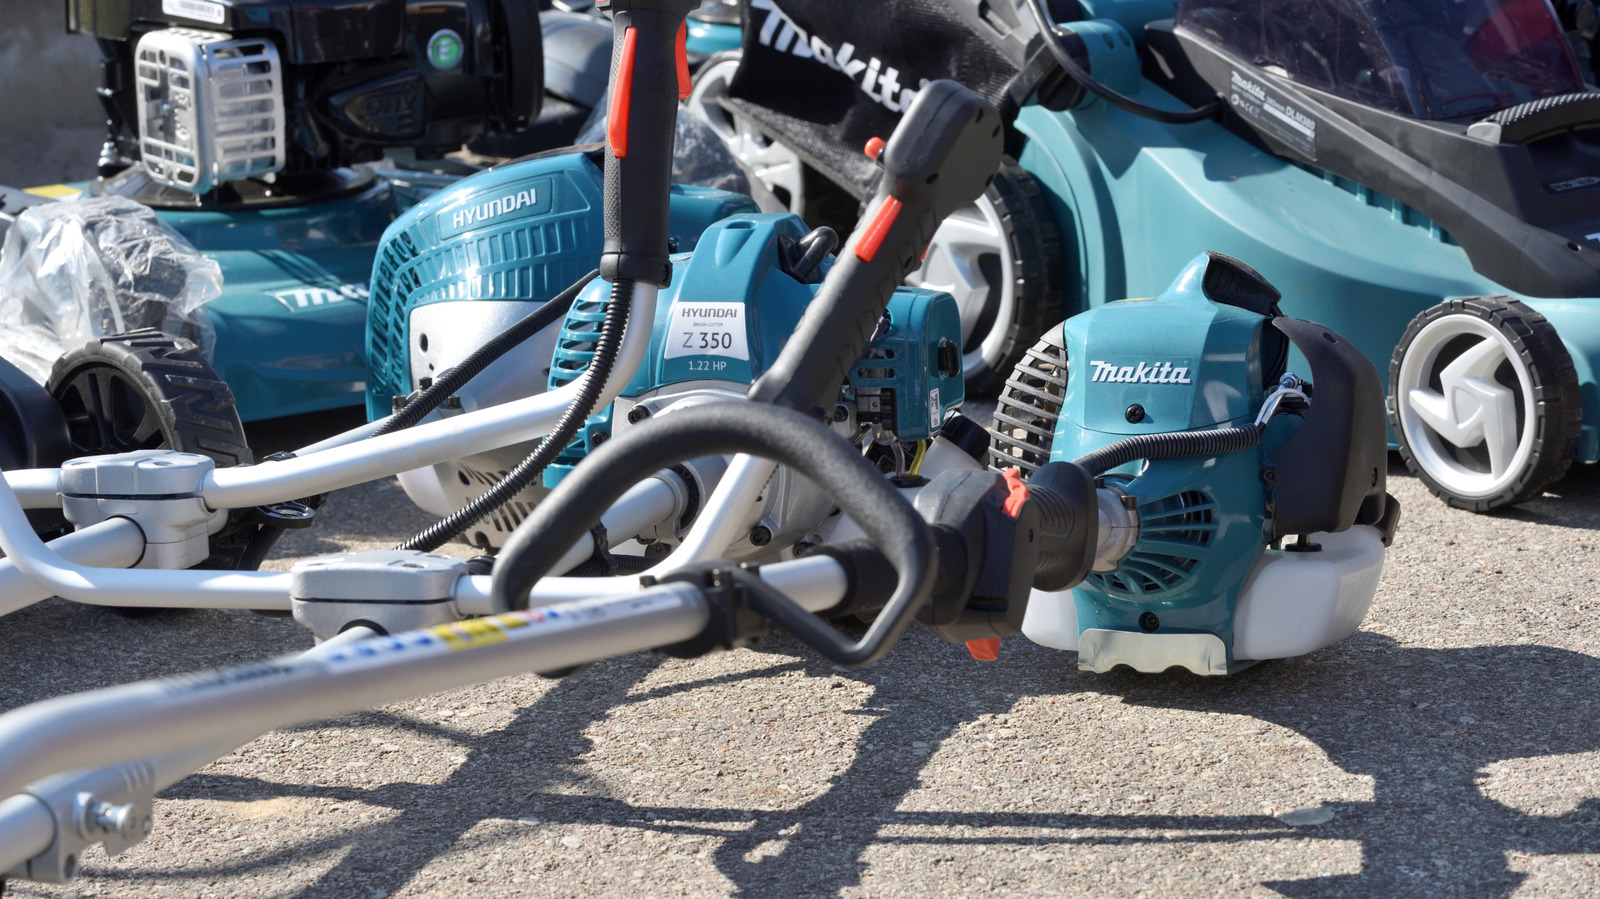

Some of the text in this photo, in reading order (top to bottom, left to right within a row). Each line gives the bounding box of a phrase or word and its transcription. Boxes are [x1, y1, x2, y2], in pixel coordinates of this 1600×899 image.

[1231, 70, 1266, 101] Makita
[453, 188, 536, 229] HYUNDAI
[682, 308, 737, 318] HYUNDAI
[682, 332, 732, 349] Z 350
[688, 360, 727, 371] 1.22 HP
[1090, 360, 1191, 384] Makita
